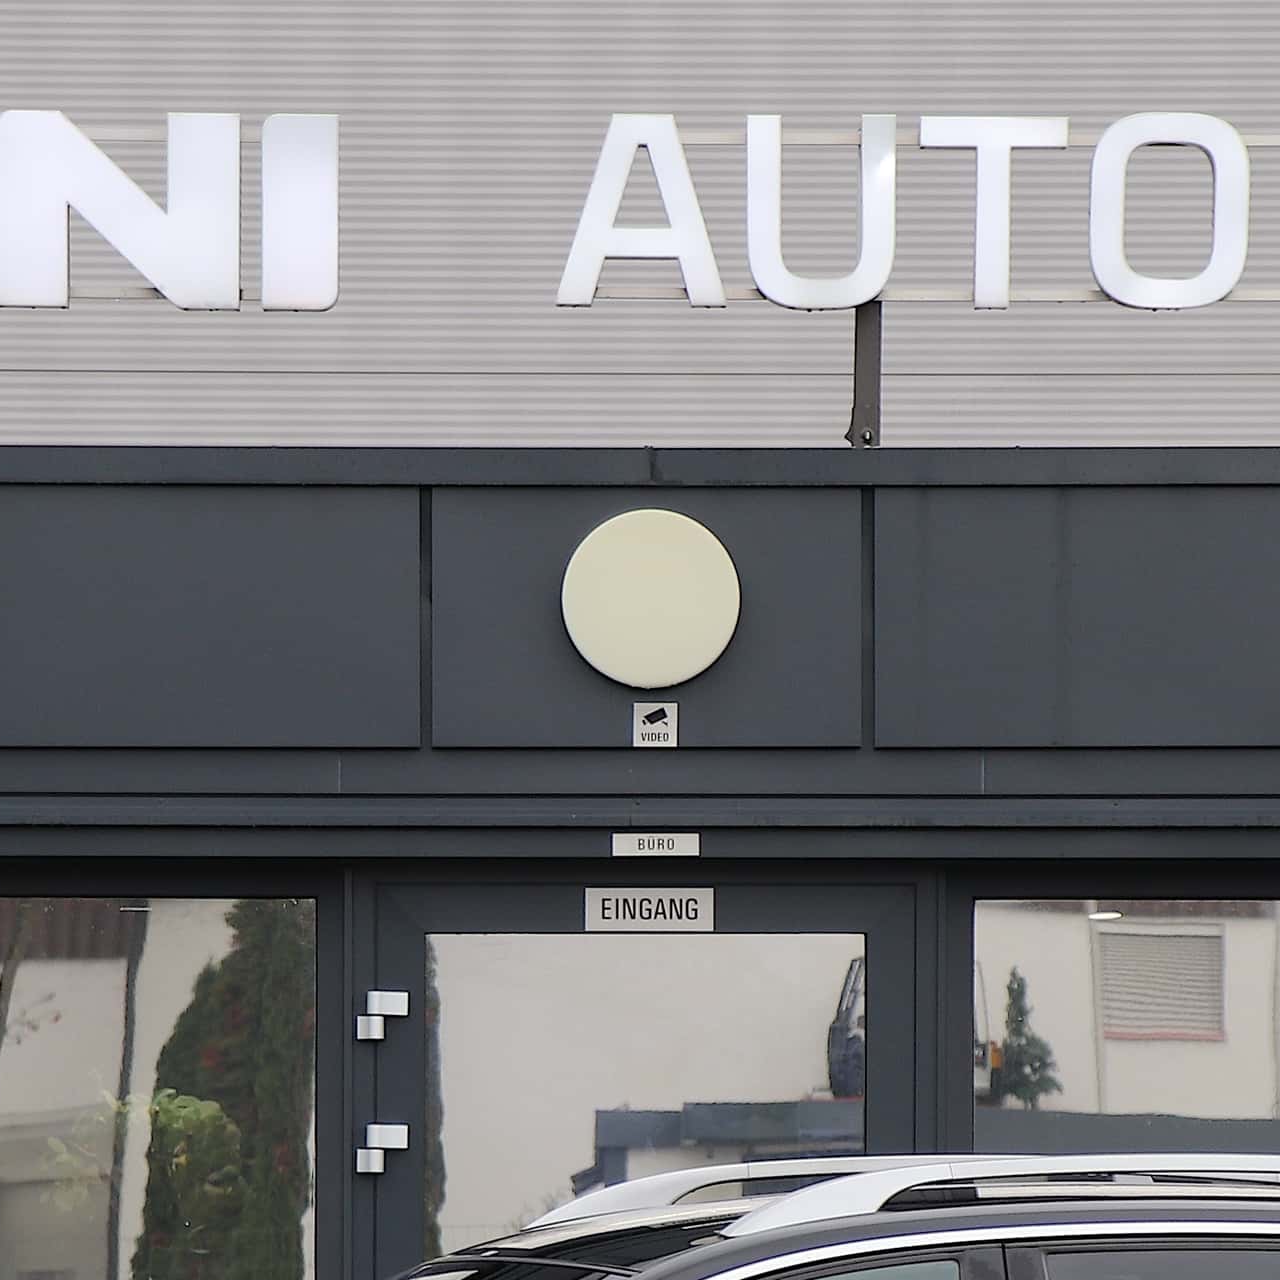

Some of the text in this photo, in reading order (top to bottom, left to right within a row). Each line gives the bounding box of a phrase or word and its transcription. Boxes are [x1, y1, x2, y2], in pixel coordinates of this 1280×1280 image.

[555, 111, 1251, 310] AUTO
[640, 732, 669, 742] VIDEO
[637, 836, 675, 850] BÜRO
[601, 897, 699, 920] EINGANG
